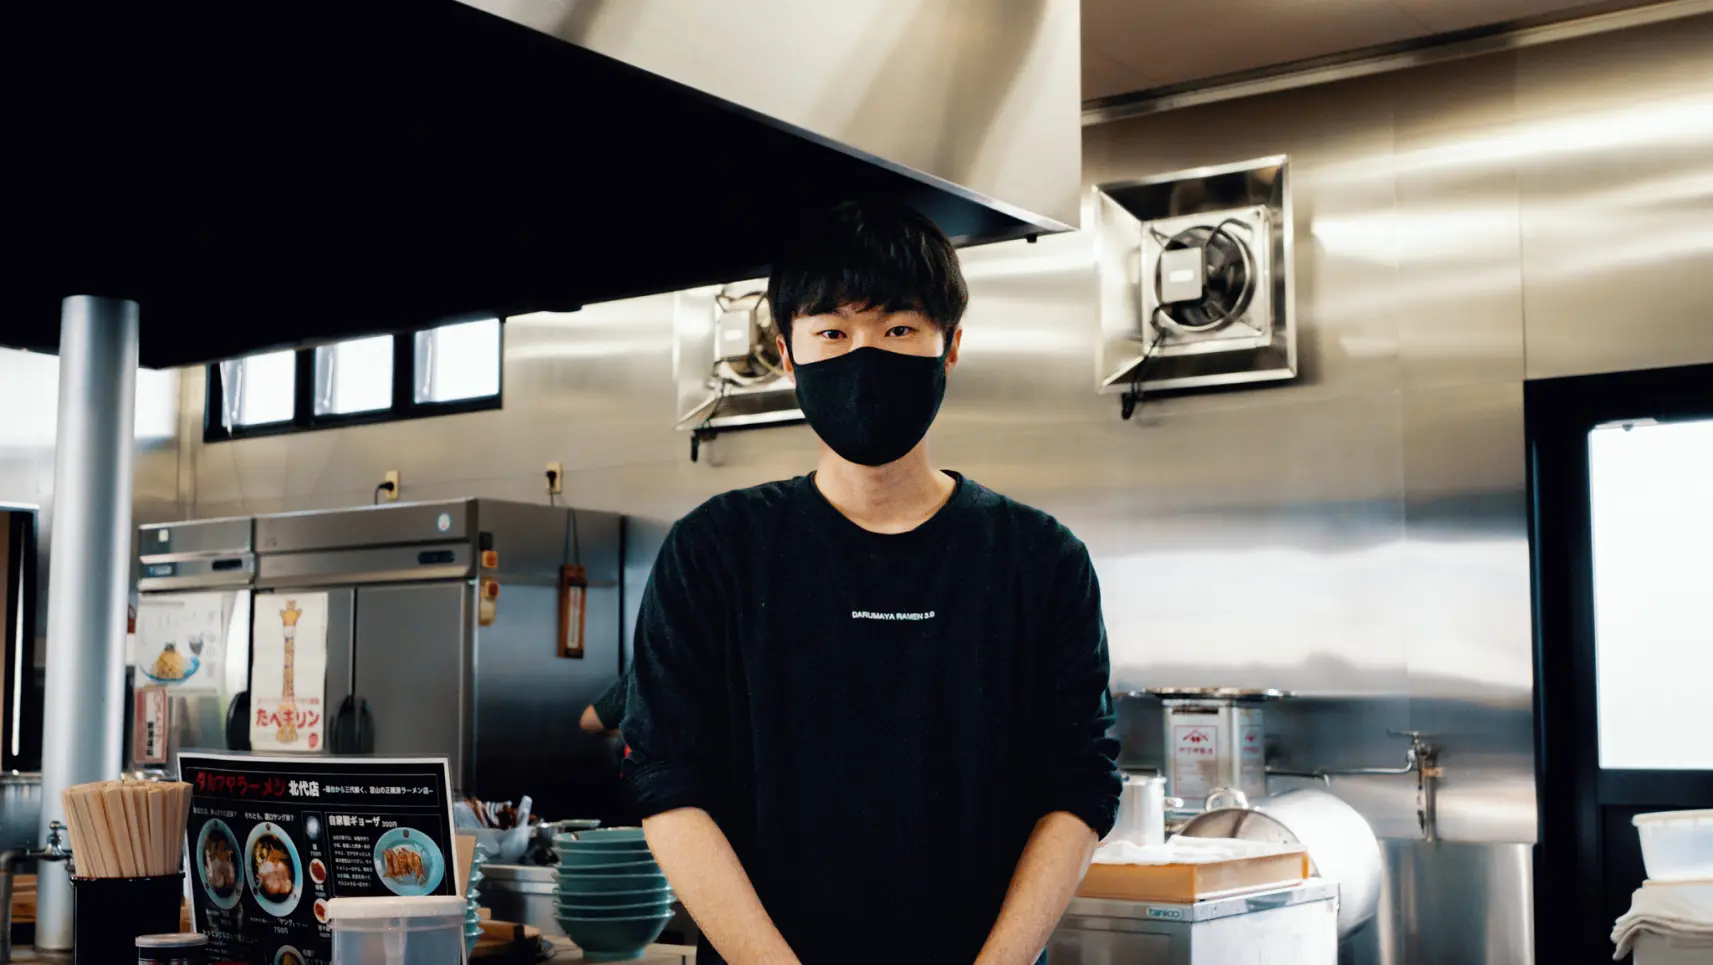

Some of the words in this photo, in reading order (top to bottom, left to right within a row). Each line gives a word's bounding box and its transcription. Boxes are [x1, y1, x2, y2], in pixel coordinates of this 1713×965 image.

[852, 611, 895, 620] DARUMAYA
[896, 612, 923, 620] RAMEN
[288, 780, 320, 797] 北代店
